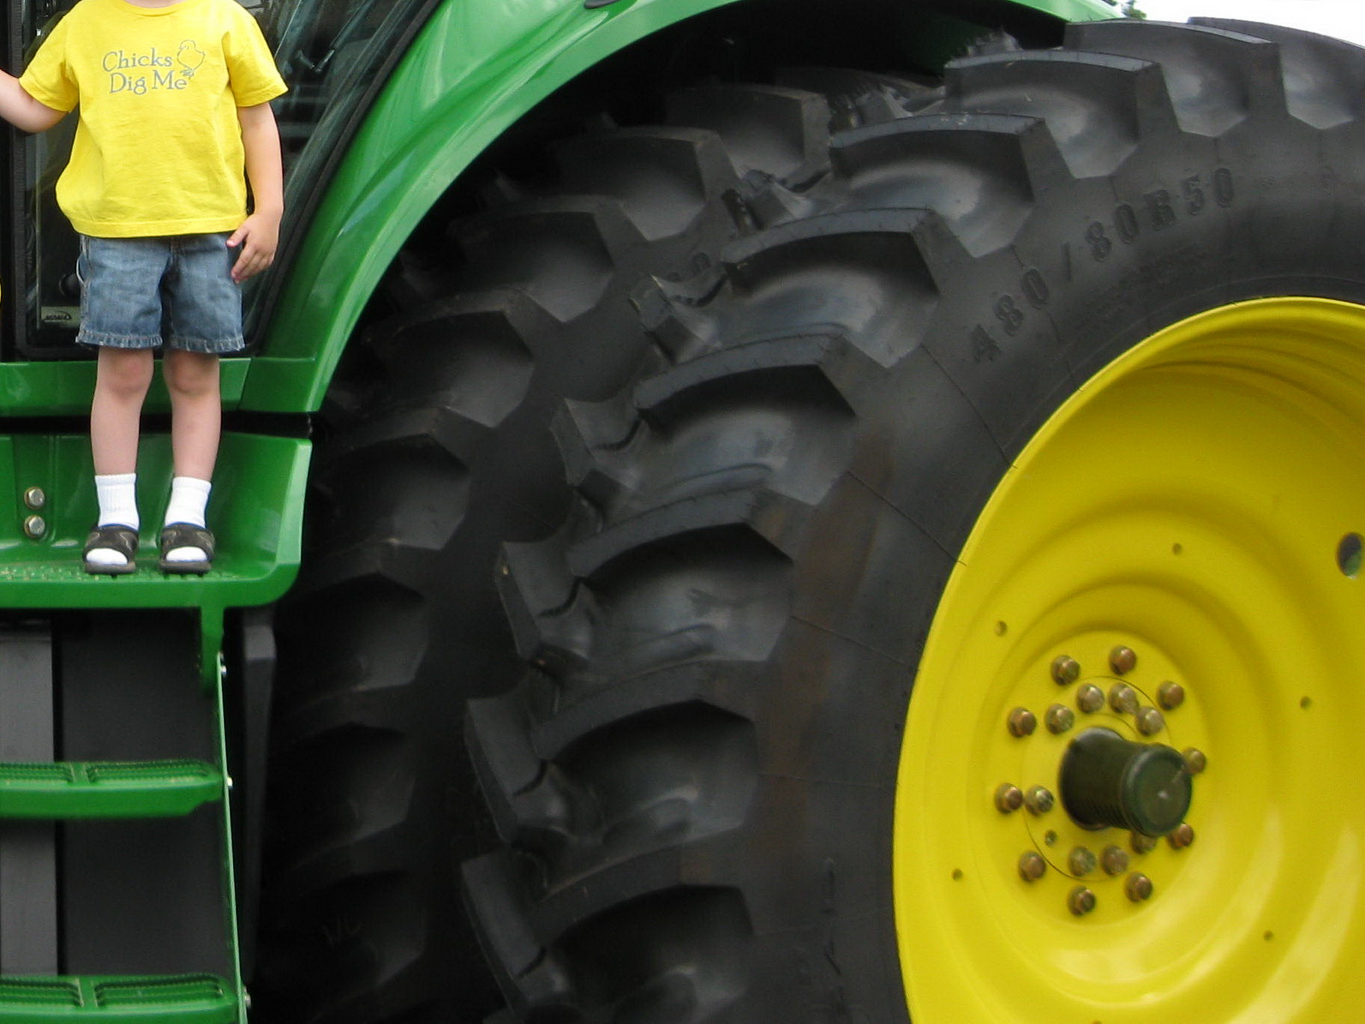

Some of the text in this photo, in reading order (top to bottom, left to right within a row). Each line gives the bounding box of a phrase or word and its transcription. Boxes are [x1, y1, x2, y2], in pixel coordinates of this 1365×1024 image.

[102, 47, 173, 72] Chicks
[109, 69, 187, 95] Dig Me
